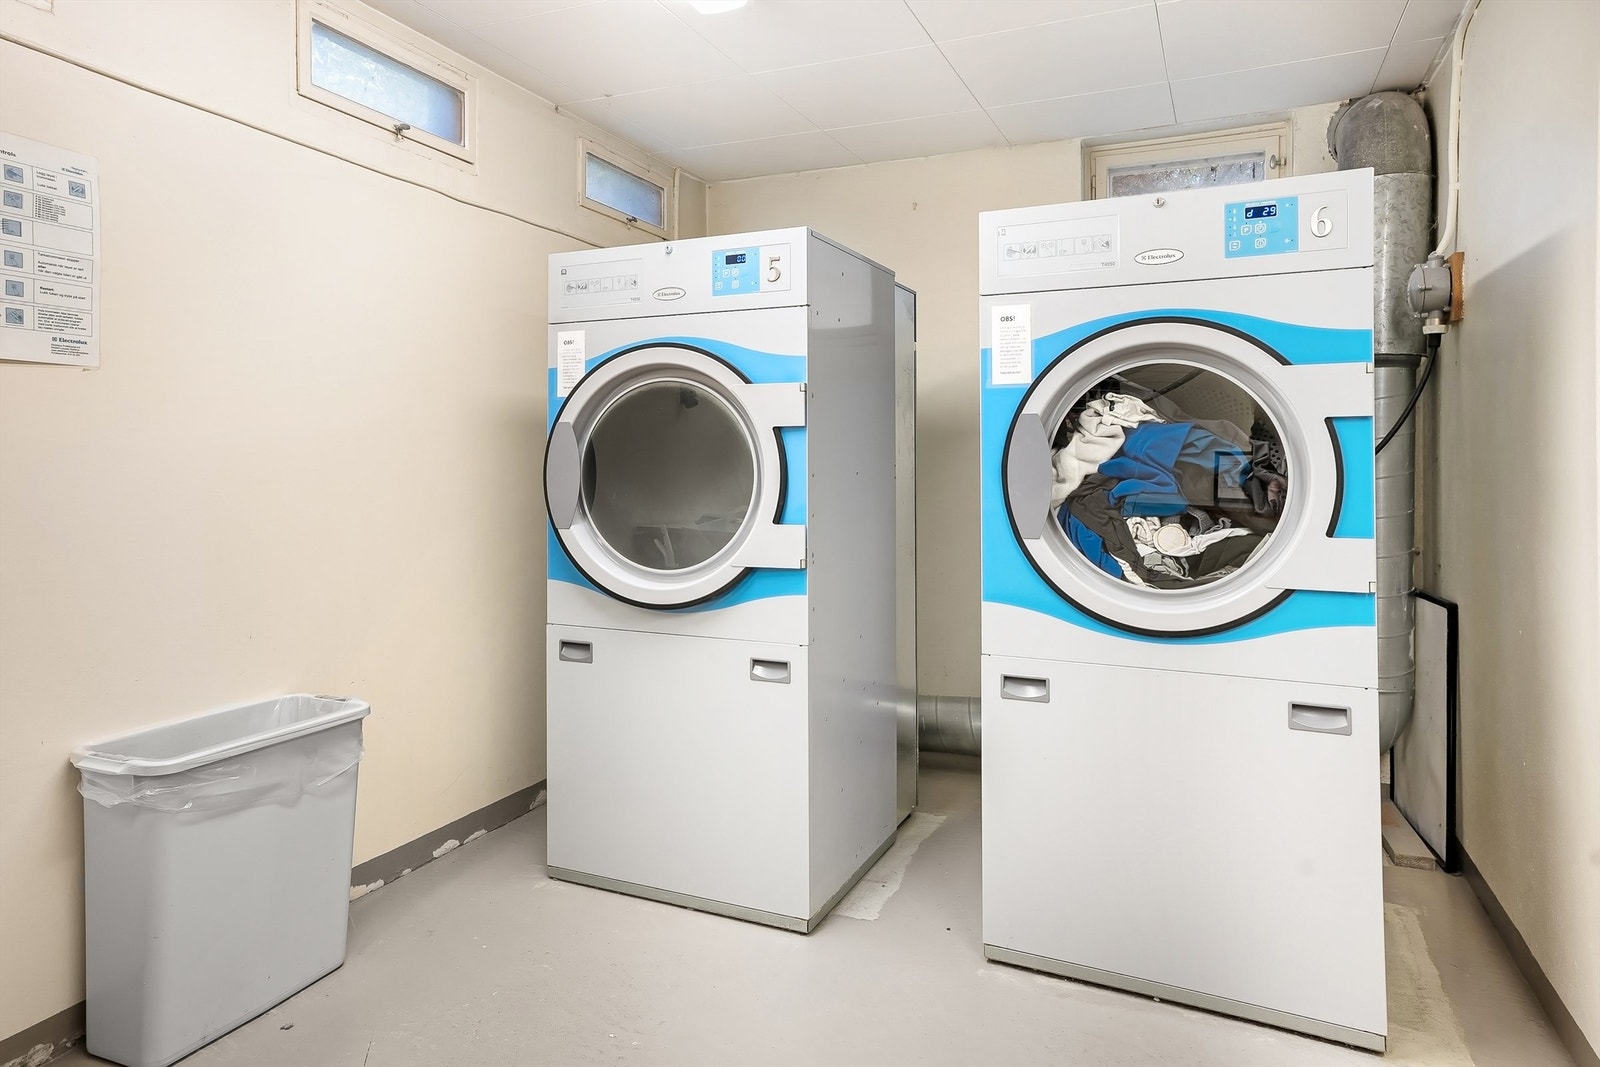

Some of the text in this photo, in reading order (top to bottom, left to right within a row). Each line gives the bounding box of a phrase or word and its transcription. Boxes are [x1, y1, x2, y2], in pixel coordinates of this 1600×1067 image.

[1262, 206, 1276, 216] 29
[1310, 205, 1333, 238] 6
[767, 256, 781, 282] 5
[58, 337, 88, 345] Electrolux
